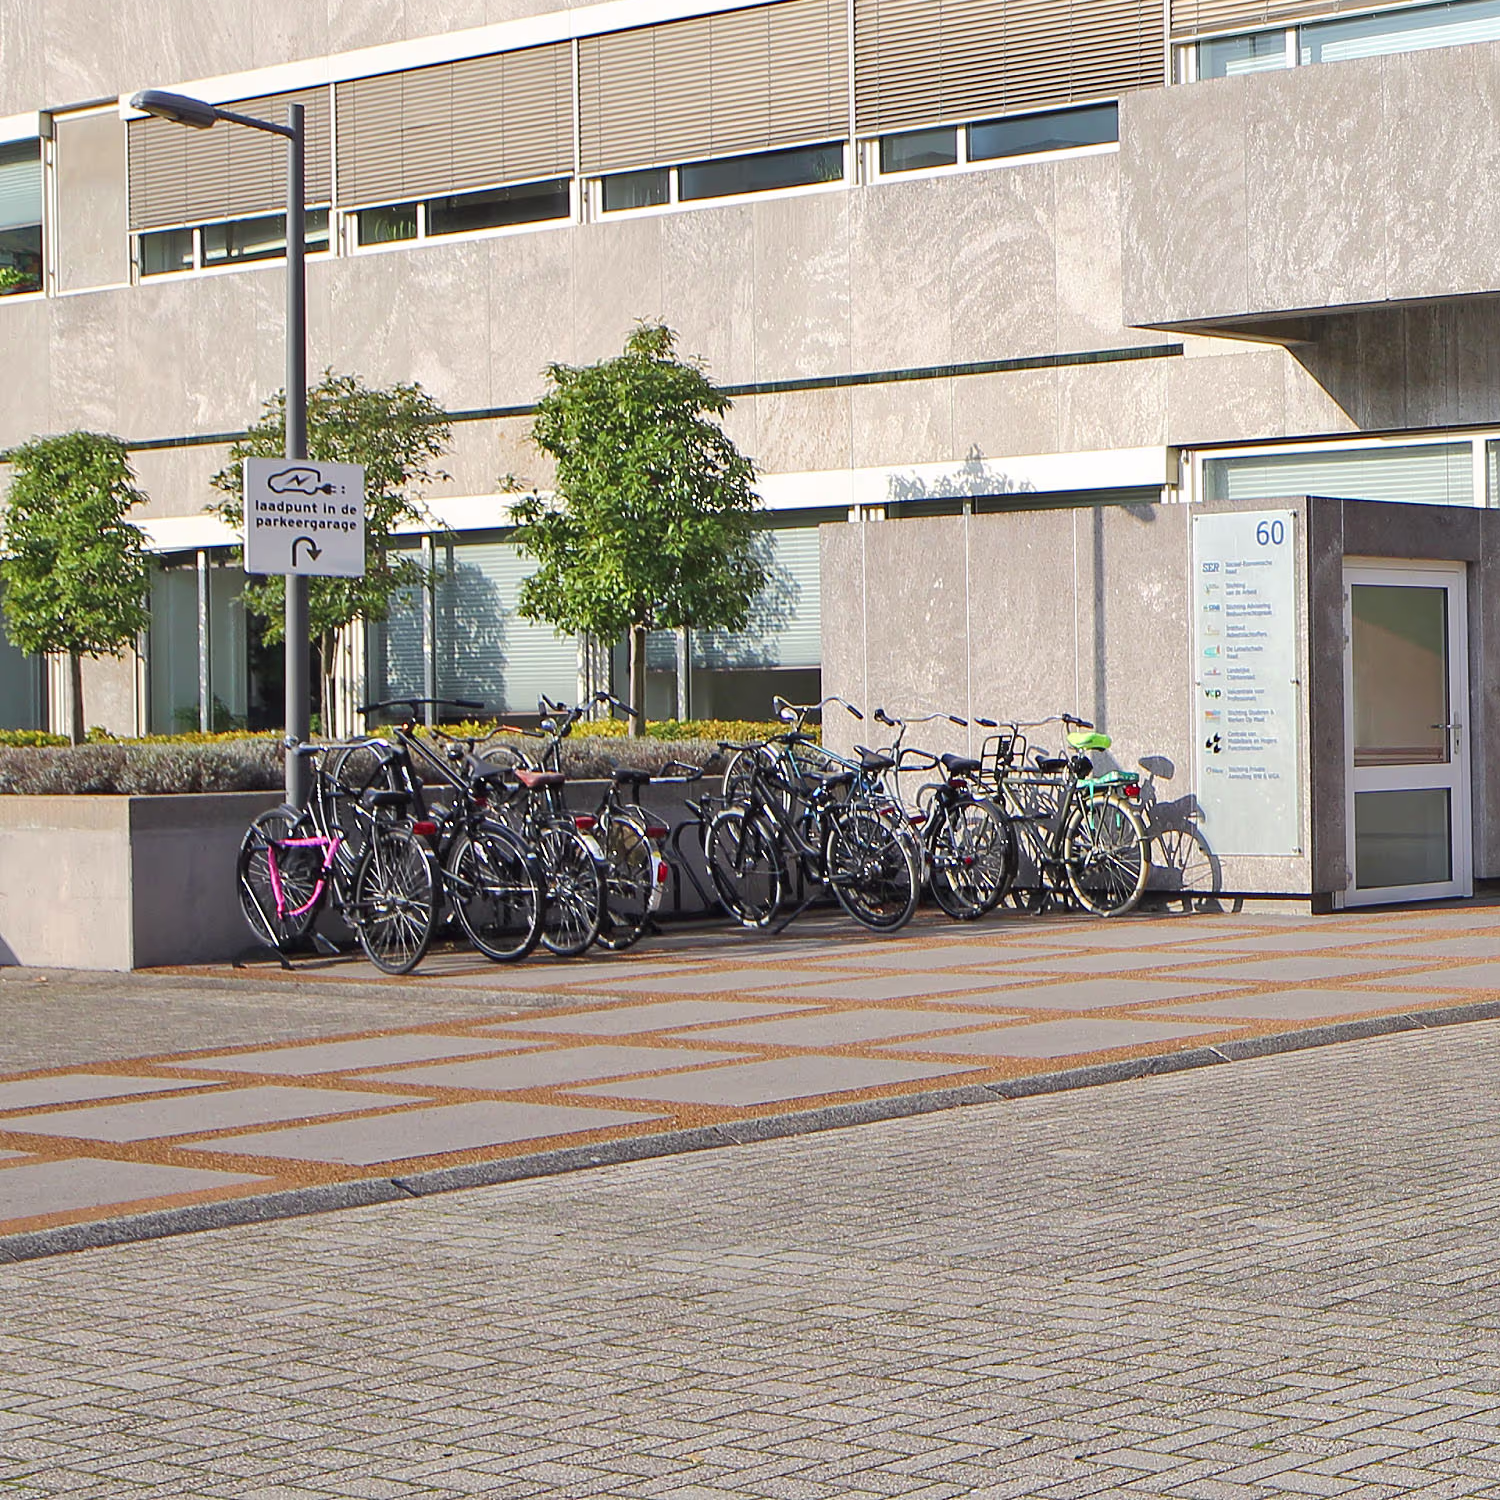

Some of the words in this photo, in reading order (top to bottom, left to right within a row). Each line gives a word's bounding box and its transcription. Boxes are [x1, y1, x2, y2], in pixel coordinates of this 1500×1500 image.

[255, 500, 318, 514] laadpunt
[323, 502, 336, 514] in
[341, 503, 357, 516] de
[256, 516, 357, 533] parkeergarage
[1256, 520, 1284, 546] 60
[1202, 563, 1220, 572] SER
